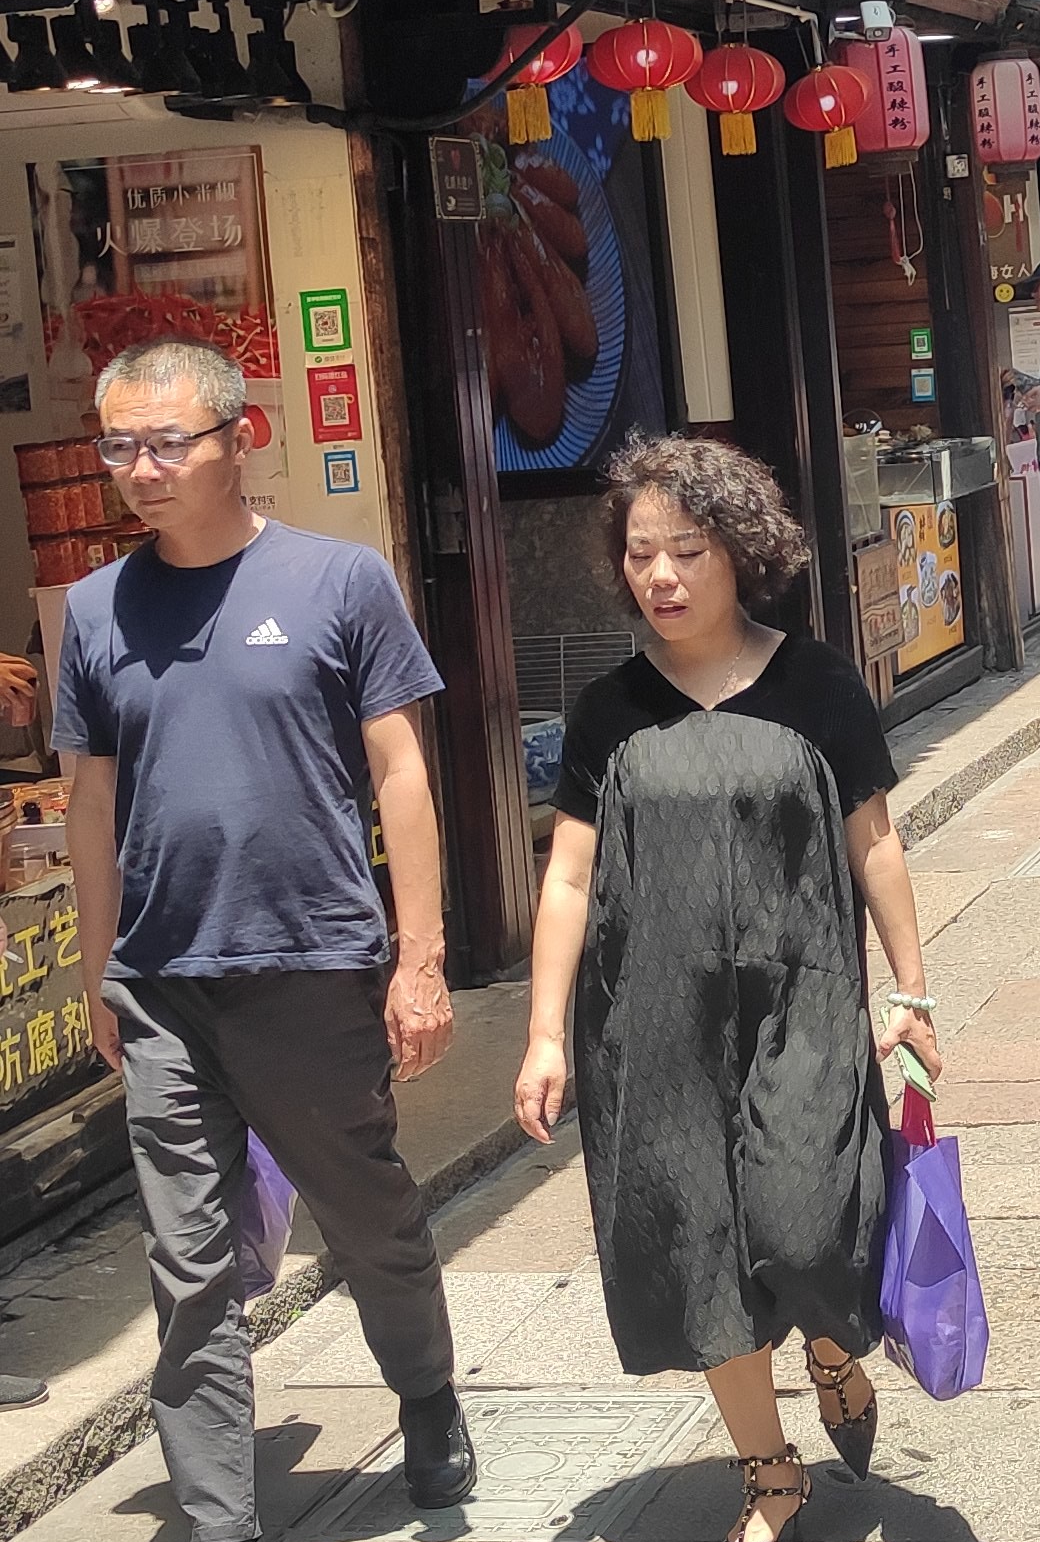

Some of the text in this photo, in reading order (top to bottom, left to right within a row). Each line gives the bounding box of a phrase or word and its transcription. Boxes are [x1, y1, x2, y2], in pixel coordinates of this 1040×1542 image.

[885, 43, 911, 130] 手工酸辣粉
[976, 77, 995, 149] 手工酸辣粉
[127, 181, 237, 210] 优质小米椒
[97, 214, 242, 258] 火爆登场
[245, 635, 289, 646] adidas
